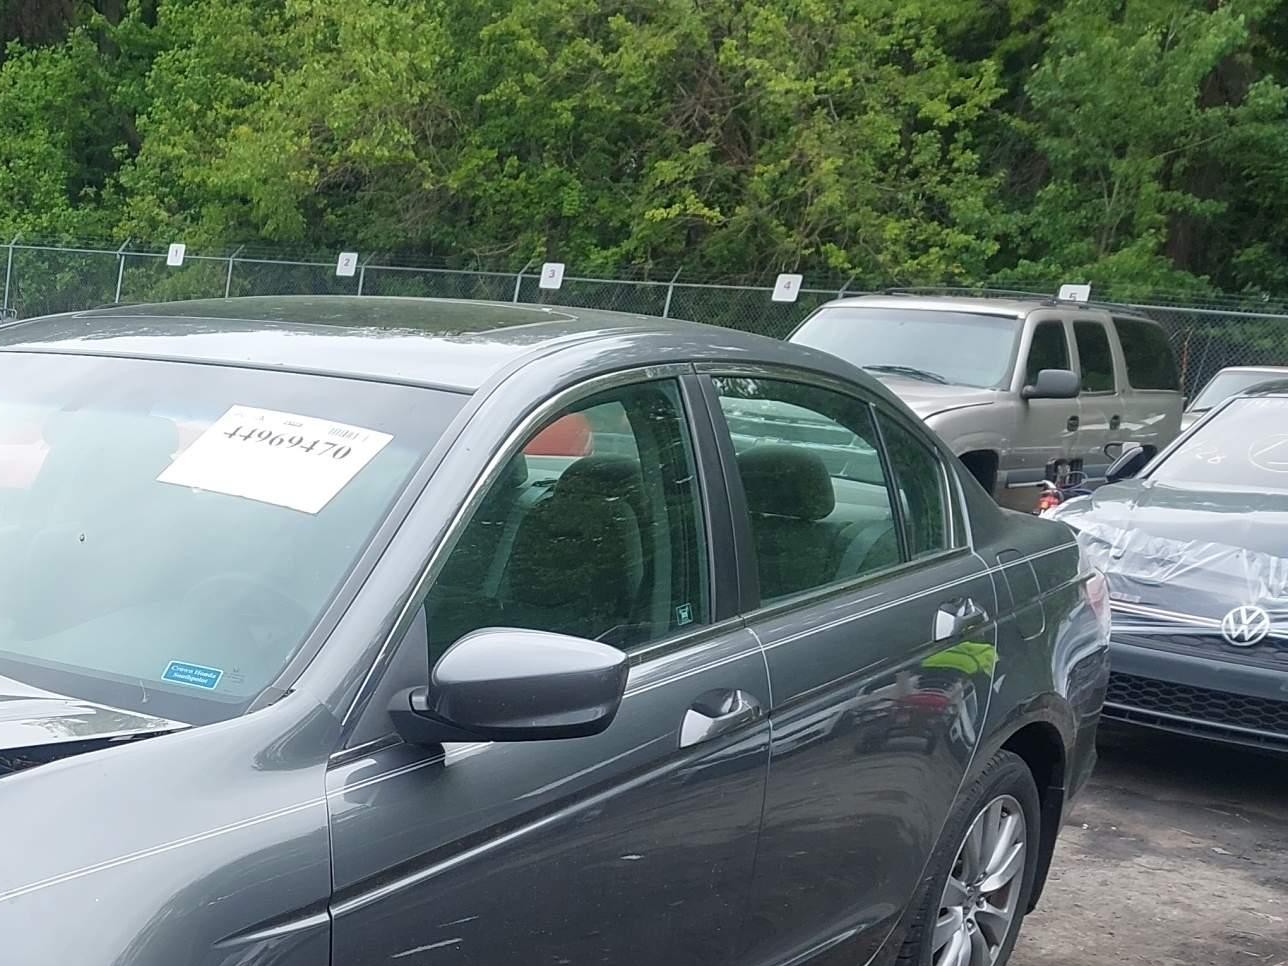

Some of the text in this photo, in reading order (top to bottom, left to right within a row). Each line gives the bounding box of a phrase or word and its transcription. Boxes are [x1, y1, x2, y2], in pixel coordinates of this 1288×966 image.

[343, 258, 351, 267] 2
[548, 269, 556, 278] 3
[783, 280, 792, 290] 4
[223, 425, 352, 460] 44969470
